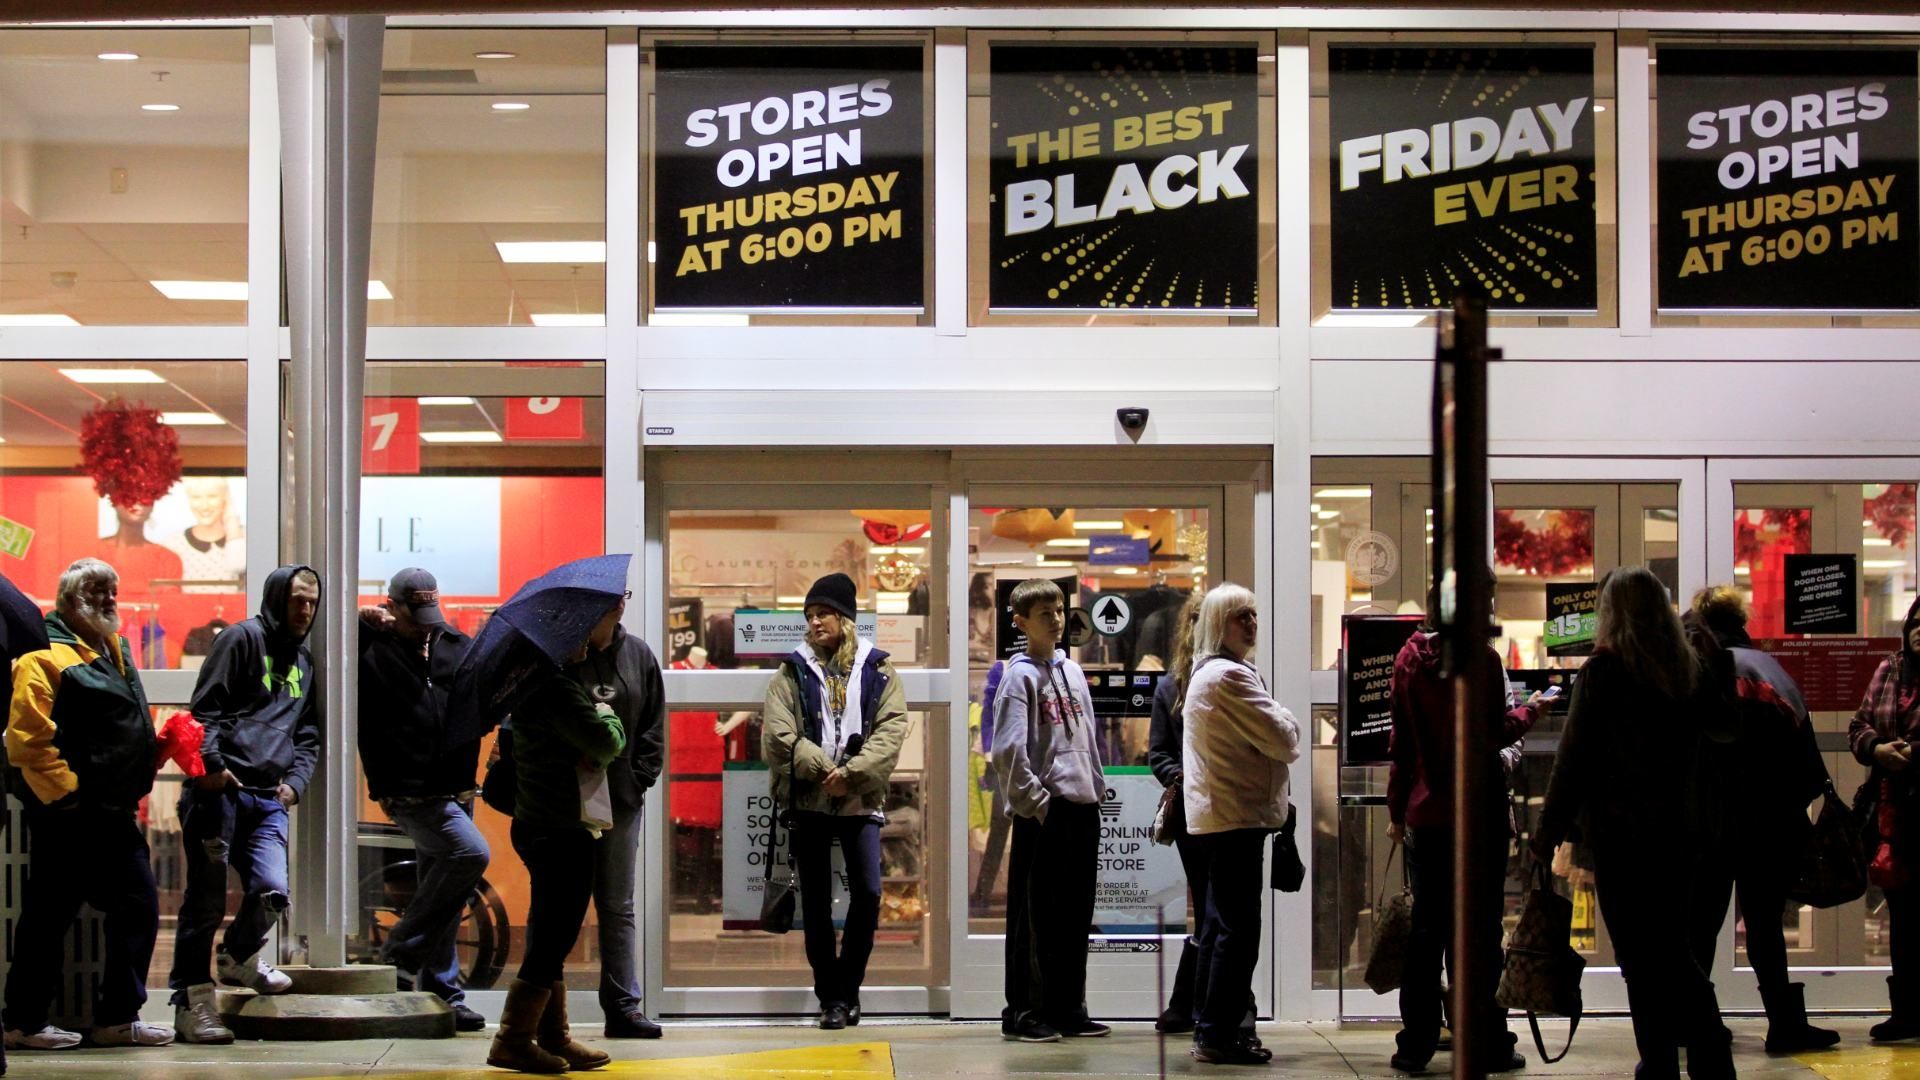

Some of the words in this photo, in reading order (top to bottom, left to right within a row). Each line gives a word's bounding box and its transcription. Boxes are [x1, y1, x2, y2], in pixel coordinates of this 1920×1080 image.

[685, 78, 893, 148] STORES
[1686, 82, 1889, 150] STORES
[1007, 122, 1100, 168] THE
[1113, 100, 1232, 151] BEST
[1340, 96, 1589, 192] FRIDAY
[716, 128, 862, 188] OPEN
[1717, 131, 1859, 190] OPEN
[1005, 144, 1250, 237] BLACK
[1434, 164, 1579, 226] EVER
[679, 171, 900, 237] THURSDAY
[1681, 174, 1896, 238] THURSDAY
[675, 239, 729, 277] AT
[740, 222, 833, 265] 6:00
[843, 209, 901, 247] PM
[1678, 241, 1731, 278] AT
[1741, 224, 1831, 266] 6:00
[1842, 211, 1898, 249] PM
[370, 412, 399, 451] 7
[1800, 567, 1824, 577] WHEN
[1824, 564, 1840, 573] ONE
[1794, 577, 1816, 587] DOOR
[1803, 582, 1838, 593] ANOTHER
[1553, 592, 1580, 606] ONLY
[1583, 591, 1597, 600] ON
[1799, 594, 1815, 602] ONE
[1561, 605, 1570, 614] A
[1572, 600, 1594, 612] YEA
[760, 624, 779, 632] BUY
[779, 624, 806, 632] ONLINE
[1106, 625, 1115, 633] IN
[1548, 613, 1581, 637] $15
[1362, 654, 1394, 667] WHEN
[1353, 668, 1383, 681] DOOR
[1365, 678, 1393, 690] ANOT
[1359, 692, 1382, 703] ONE
[1361, 718, 1393, 728] temporari
[1351, 728, 1371, 737] Please
[747, 796, 774, 810] FO
[747, 815, 772, 828] SO
[1099, 826, 1152, 839] ONLIN
[747, 833, 786, 847] YOU
[1119, 843, 1141, 855] UP
[747, 852, 787, 866] ONL
